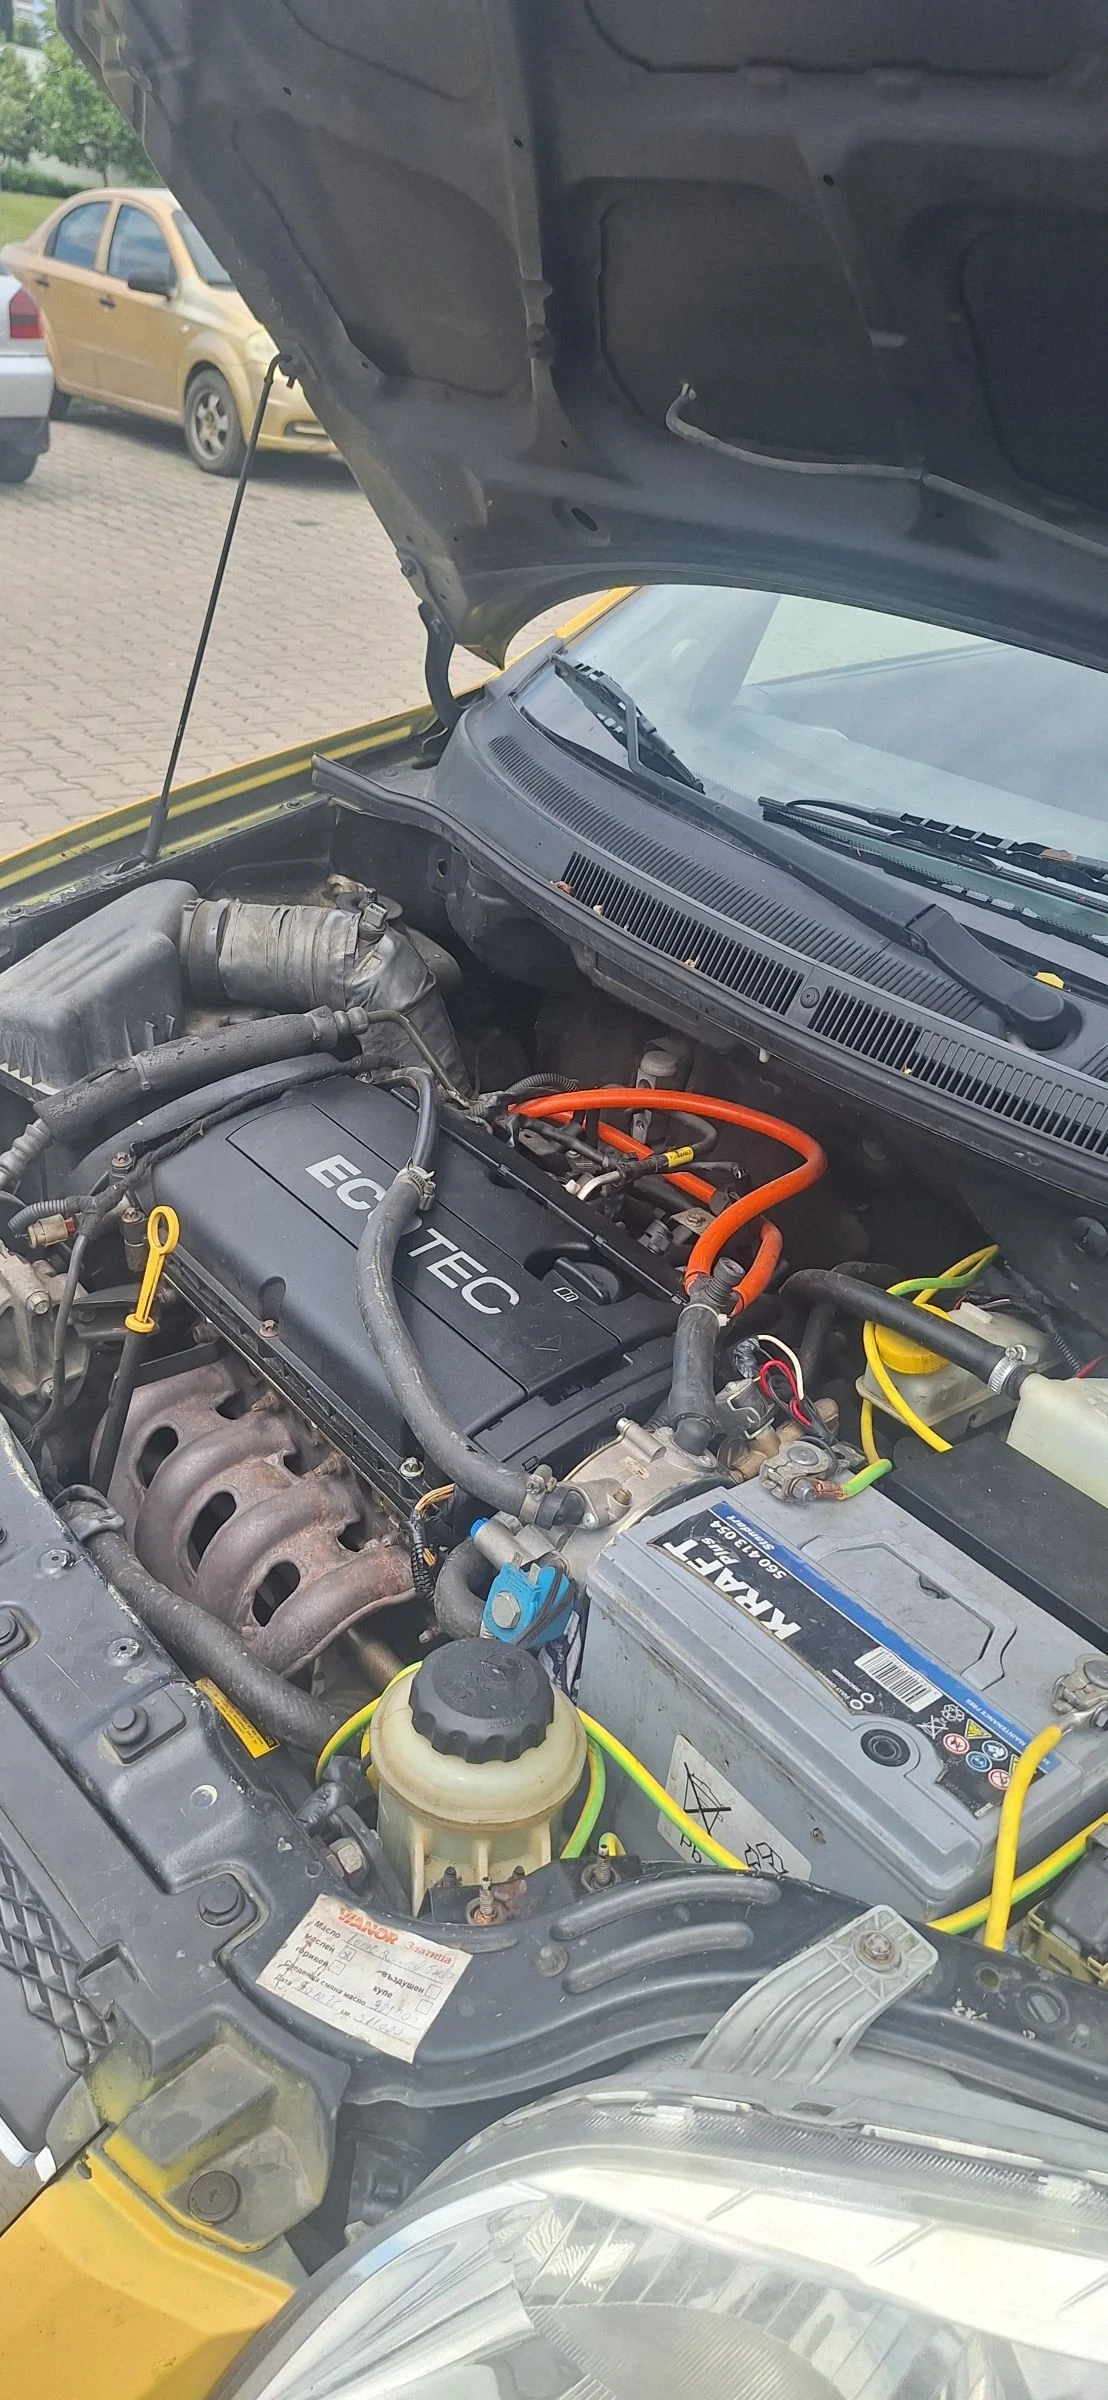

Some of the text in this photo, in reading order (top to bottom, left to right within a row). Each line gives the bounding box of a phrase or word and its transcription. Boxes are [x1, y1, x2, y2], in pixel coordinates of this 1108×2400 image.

[305, 1154, 520, 1315] ECTEC
[726, 1515, 776, 1551] Standart
[701, 1537, 741, 1565] Plus
[709, 1520, 788, 1580] 560 413 054
[663, 1539, 802, 1640] KRAFT
[965, 1698, 1027, 1747] MAINTENANCE FREE
[680, 1833, 702, 1863] Pb
[304, 1932, 336, 1953] маслен
[314, 1920, 341, 1939] Масло
[295, 1946, 329, 1968] горивен
[372, 1985, 394, 1999] купе
[382, 1970, 426, 1994] въздушен
[343, 1991, 367, 2006] масло
